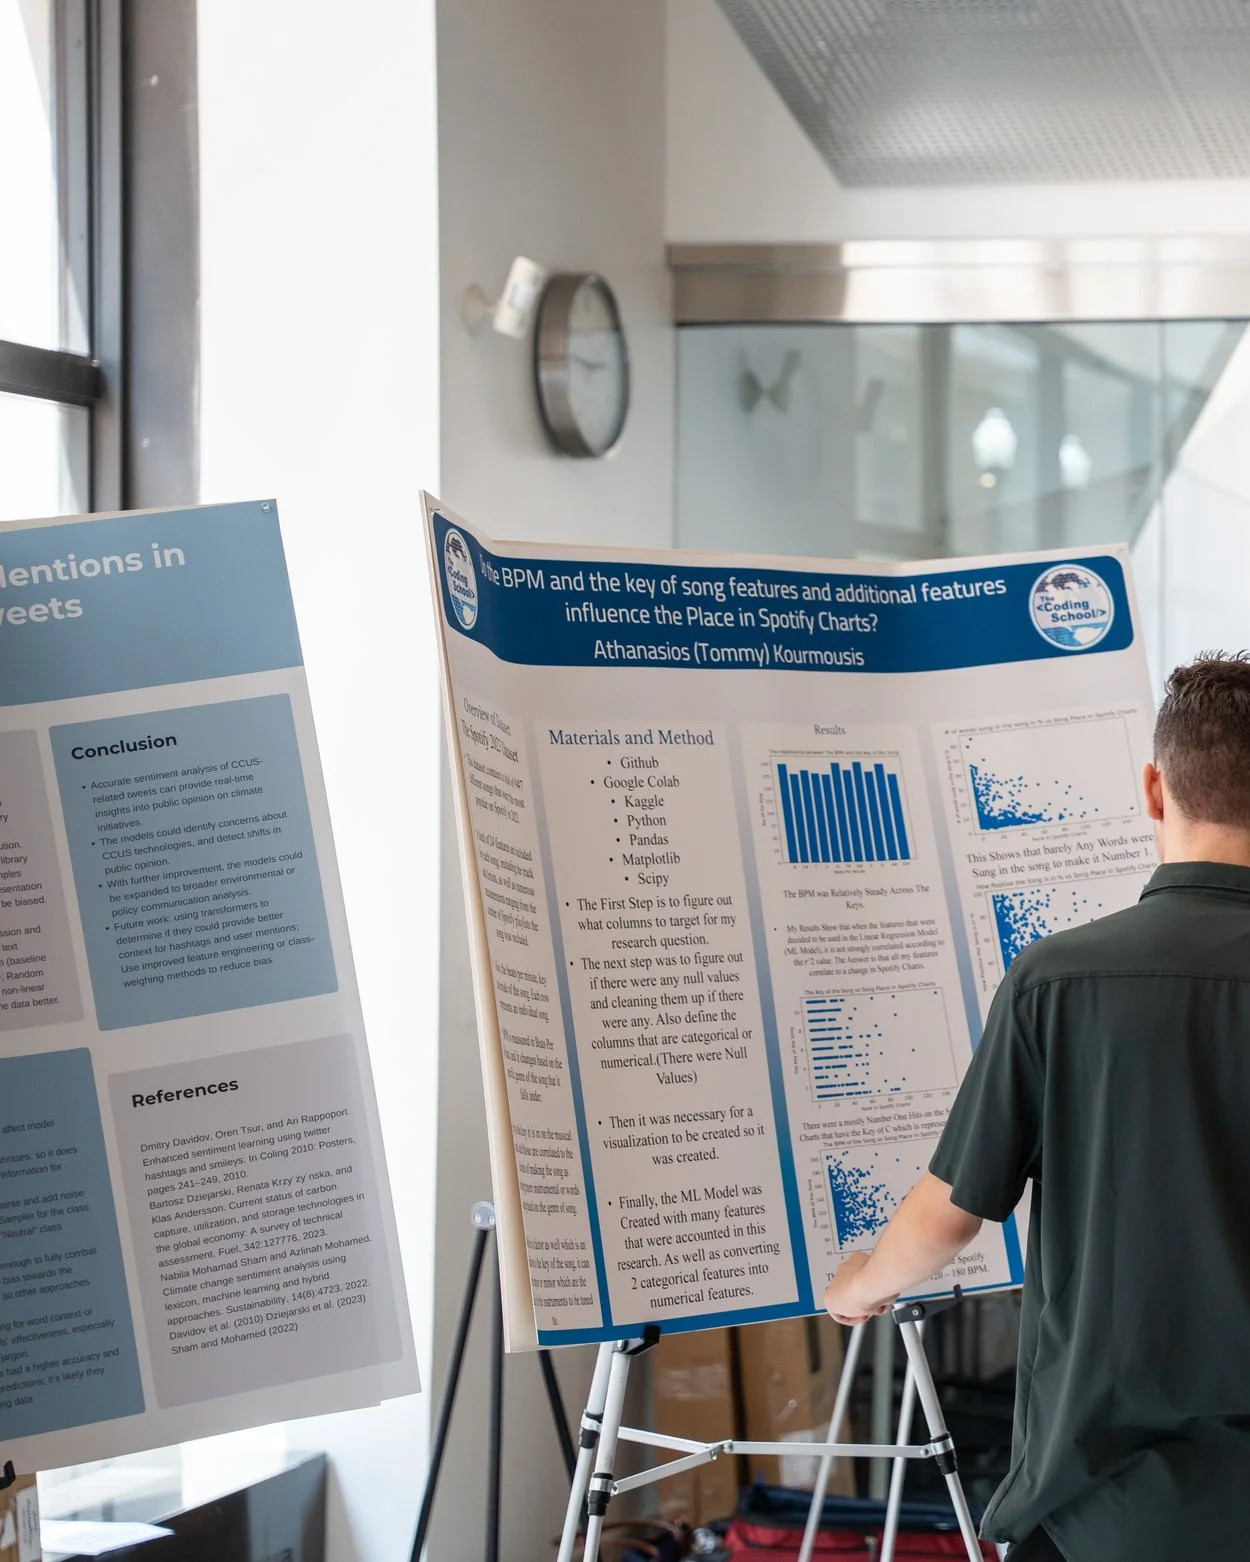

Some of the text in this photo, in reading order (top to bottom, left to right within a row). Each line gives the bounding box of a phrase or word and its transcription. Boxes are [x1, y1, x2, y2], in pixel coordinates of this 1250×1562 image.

[0, 542, 186, 589] entions in
[487, 563, 501, 586] the
[502, 567, 545, 590] BPM
[550, 571, 585, 592] and
[589, 571, 621, 593] the
[625, 572, 656, 599] key
[660, 575, 678, 595] of
[682, 580, 727, 602] song
[729, 577, 799, 601] features
[802, 582, 832, 602] and
[835, 583, 917, 605] additional
[921, 578, 1007, 602] features
[0, 598, 84, 627] eets
[565, 602, 879, 636] influence the Place in Spotify Charts?
[594, 639, 865, 668] Athanasios (Tommy) Kourmousis
[548, 729, 714, 745] Materials and Method
[814, 724, 846, 735] Results
[71, 735, 177, 759] Conclusion
[90, 757, 264, 789] Accurate sentiment analysis of CCUS-
[620, 756, 659, 768] Github
[92, 774, 254, 803] related tweets can provide real-time
[603, 775, 679, 791] Google Colab
[624, 794, 664, 810] Kaggle
[626, 814, 666, 829] Python
[629, 833, 669, 846] Pandas
[966, 853, 987, 863] This
[988, 851, 1021, 861] Shows
[1022, 847, 1041, 857] that
[1043, 843, 1071, 854] barely
[1076, 841, 1094, 850] Any
[1097, 835, 1128, 847] Words
[1131, 834, 1153, 843] were
[622, 852, 680, 868] Matplotlib
[972, 868, 996, 877] Sung
[1010, 863, 1025, 873] the
[1028, 862, 1051, 872] song
[1052, 860, 1062, 868] to
[1064, 856, 1090, 867] make
[1093, 855, 1099, 863] it
[1101, 849, 1140, 861] Number
[638, 872, 668, 887] Scipy
[576, 894, 732, 911] The First Step is to figure out
[578, 912, 736, 930] what columns to target for my
[611, 933, 709, 950] research question.
[132, 1080, 238, 1108] References
[140, 1108, 350, 1152] Dmitry Davidov, Oren Tsur, and Ari Rappoport.
[147, 1184, 176, 1197] pages
[223, 1170, 248, 1182] 2010.
[619, 1184, 762, 1209] Finally, the ML Model was
[620, 1205, 765, 1229] Created with many features
[624, 1222, 766, 1249] that were accounted in this
[617, 1241, 780, 1270] research. As well as converting
[631, 1262, 769, 1290] 2 categorical features into
[650, 1286, 753, 1308] numerical features.
